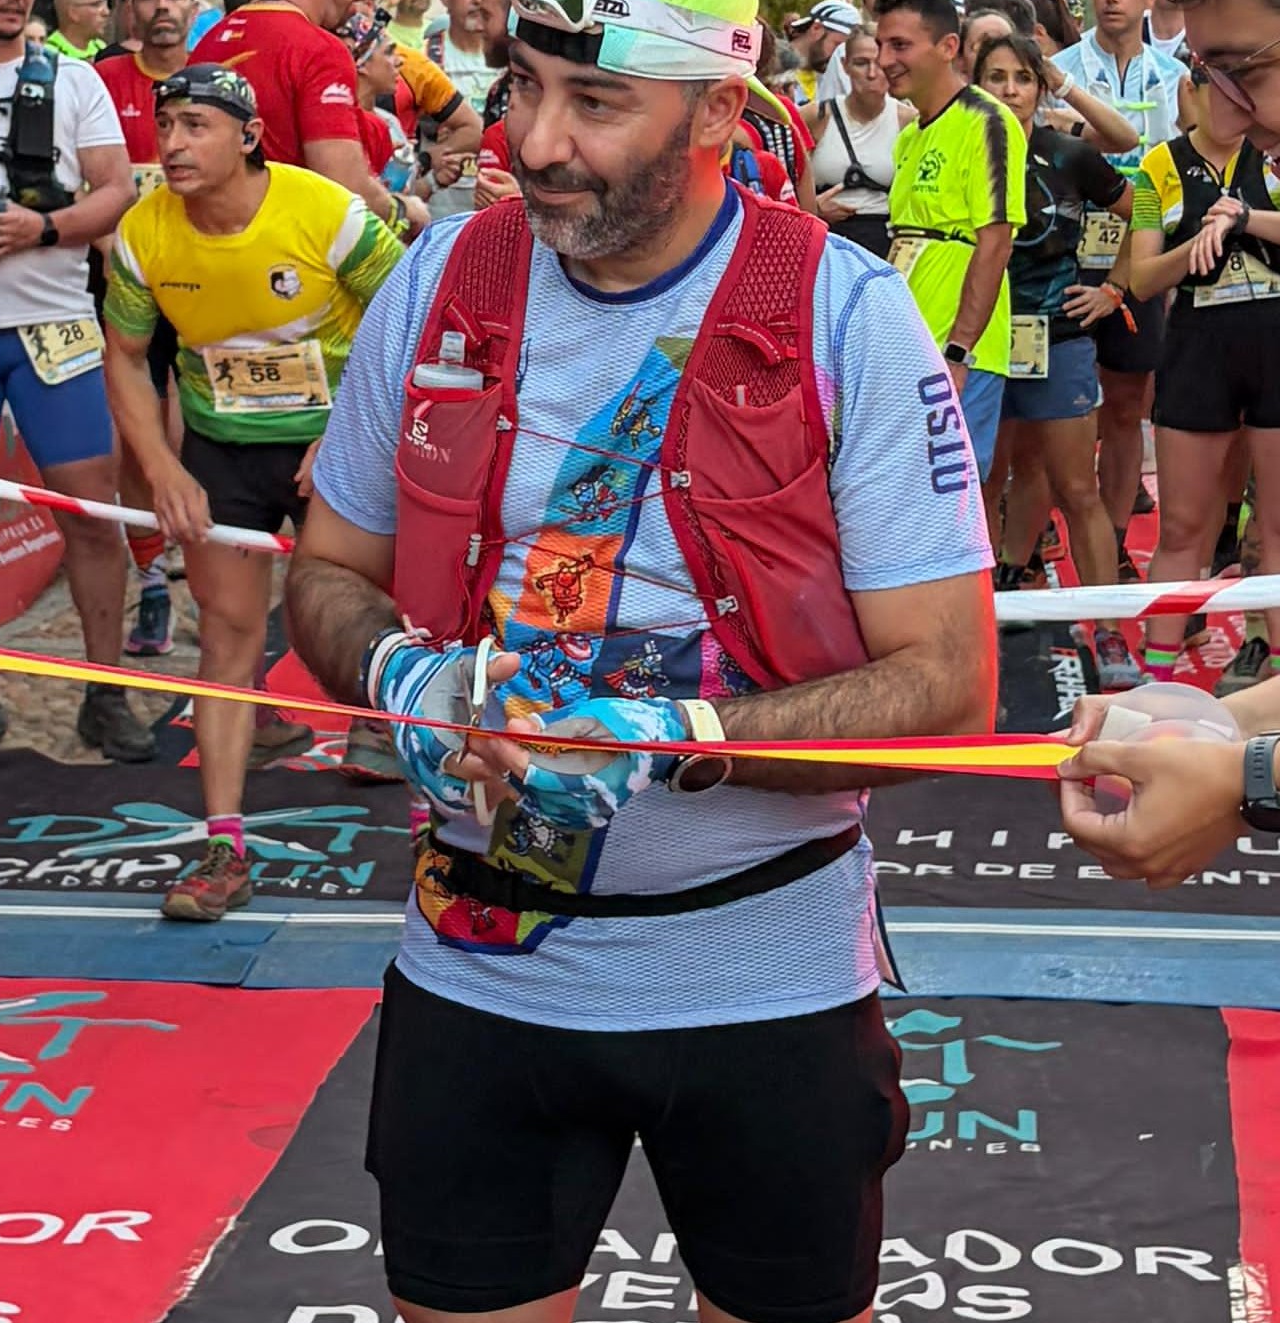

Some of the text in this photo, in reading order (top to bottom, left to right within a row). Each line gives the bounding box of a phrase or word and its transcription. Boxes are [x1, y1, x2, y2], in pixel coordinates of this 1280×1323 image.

[59, 324, 84, 345] 28
[250, 367, 280, 382] 58
[975, 863, 1056, 880] DE
